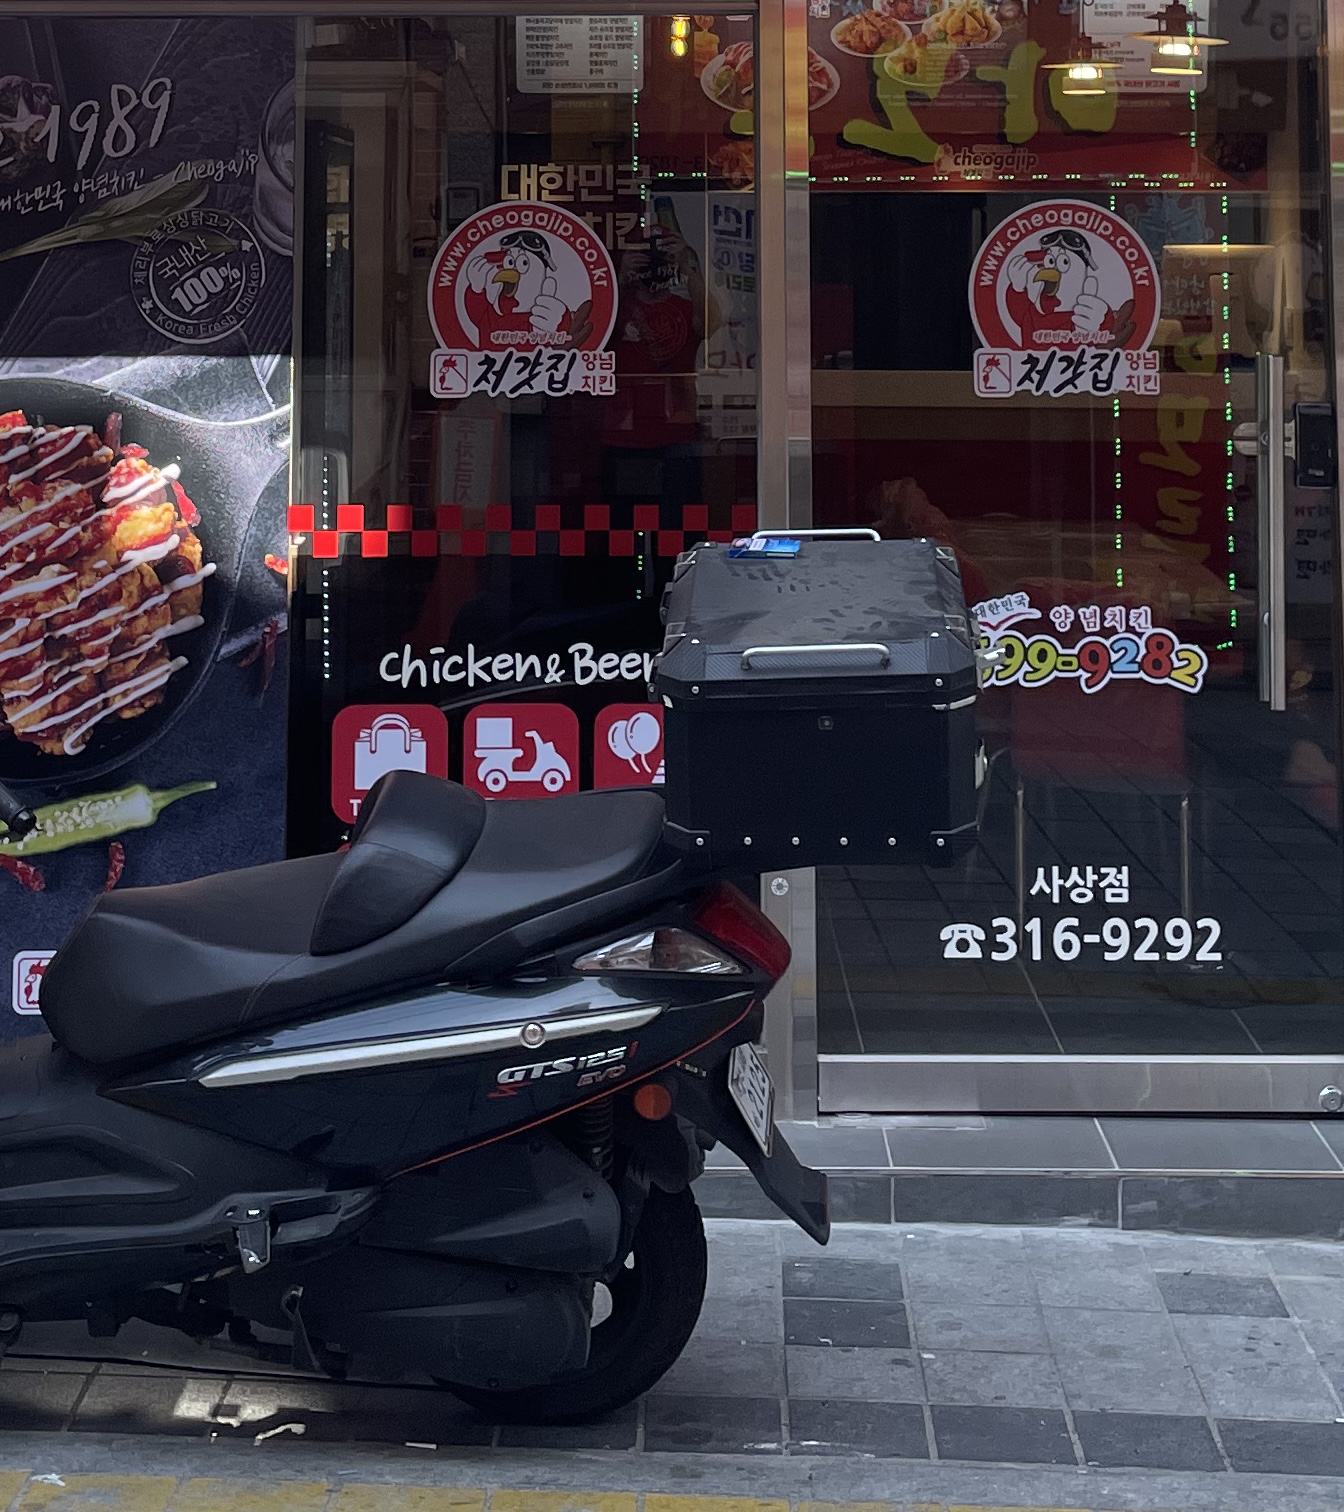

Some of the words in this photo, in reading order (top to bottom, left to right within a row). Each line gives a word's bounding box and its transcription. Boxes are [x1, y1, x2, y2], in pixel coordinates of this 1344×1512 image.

[34, 78, 174, 170] 1989
[953, 148, 1038, 172] cheogajip
[73, 172, 145, 206] 양념치킨
[156, 235, 211, 279] 국내산
[438, 210, 608, 288] www.cheogajip.co.kr
[980, 205, 1149, 287] www.cheogajip.co.kr
[157, 314, 194, 335] Korea
[200, 314, 238, 335] Fresh
[236, 262, 260, 314] Chicken
[171, 262, 241, 312] 100%
[472, 349, 577, 394] 처갓집
[582, 353, 613, 371] 양념
[1016, 349, 1121, 393] 처갓집
[1125, 351, 1158, 369] 양념
[582, 376, 613, 393] 치킨
[1125, 374, 1158, 393] 치킨
[974, 594, 1028, 618] 대한민국
[1052, 607, 1150, 630] 양념치킨
[1030, 865, 1130, 902] 사상점
[990, 917, 1223, 963] 316-9292
